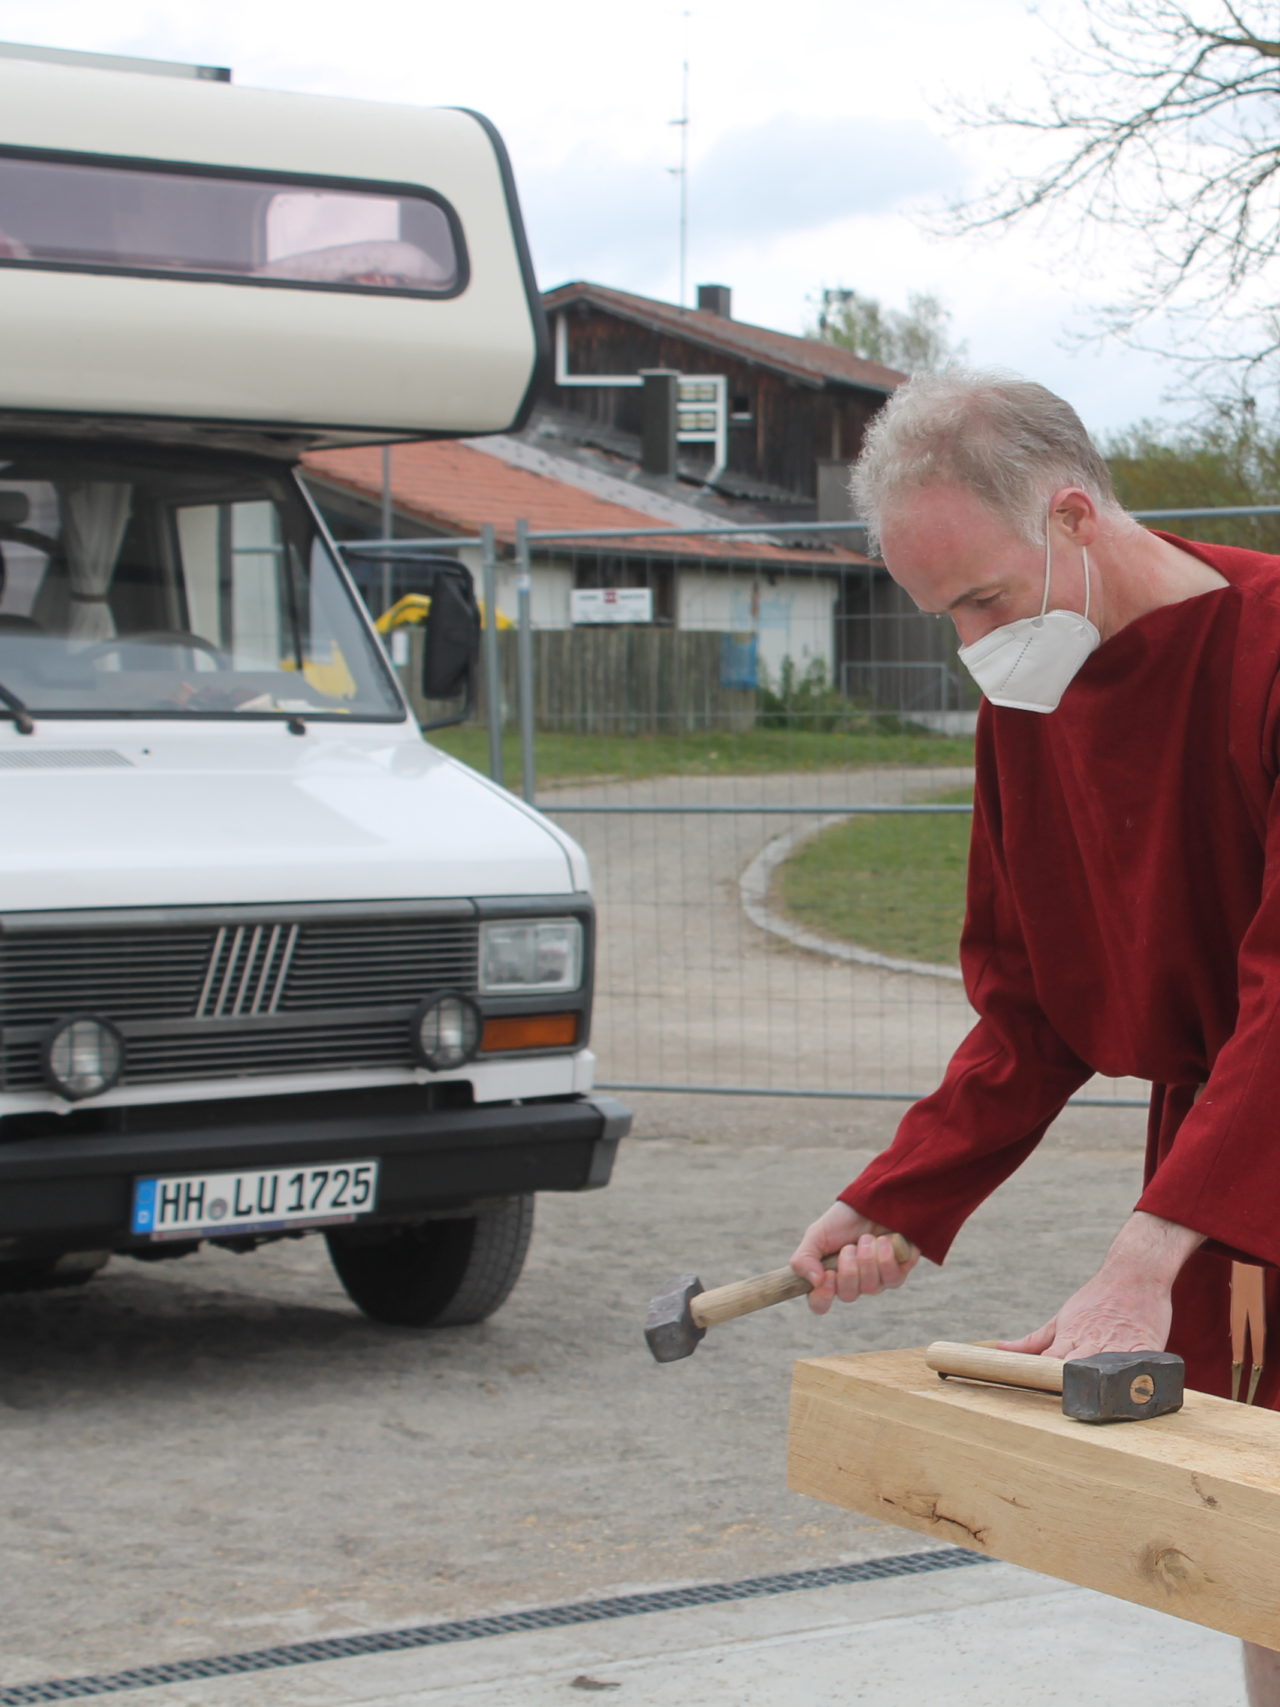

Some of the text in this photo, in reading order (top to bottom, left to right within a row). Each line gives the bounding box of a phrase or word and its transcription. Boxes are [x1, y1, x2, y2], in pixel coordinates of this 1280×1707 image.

[158, 1167, 372, 1224] HH LU 1725
